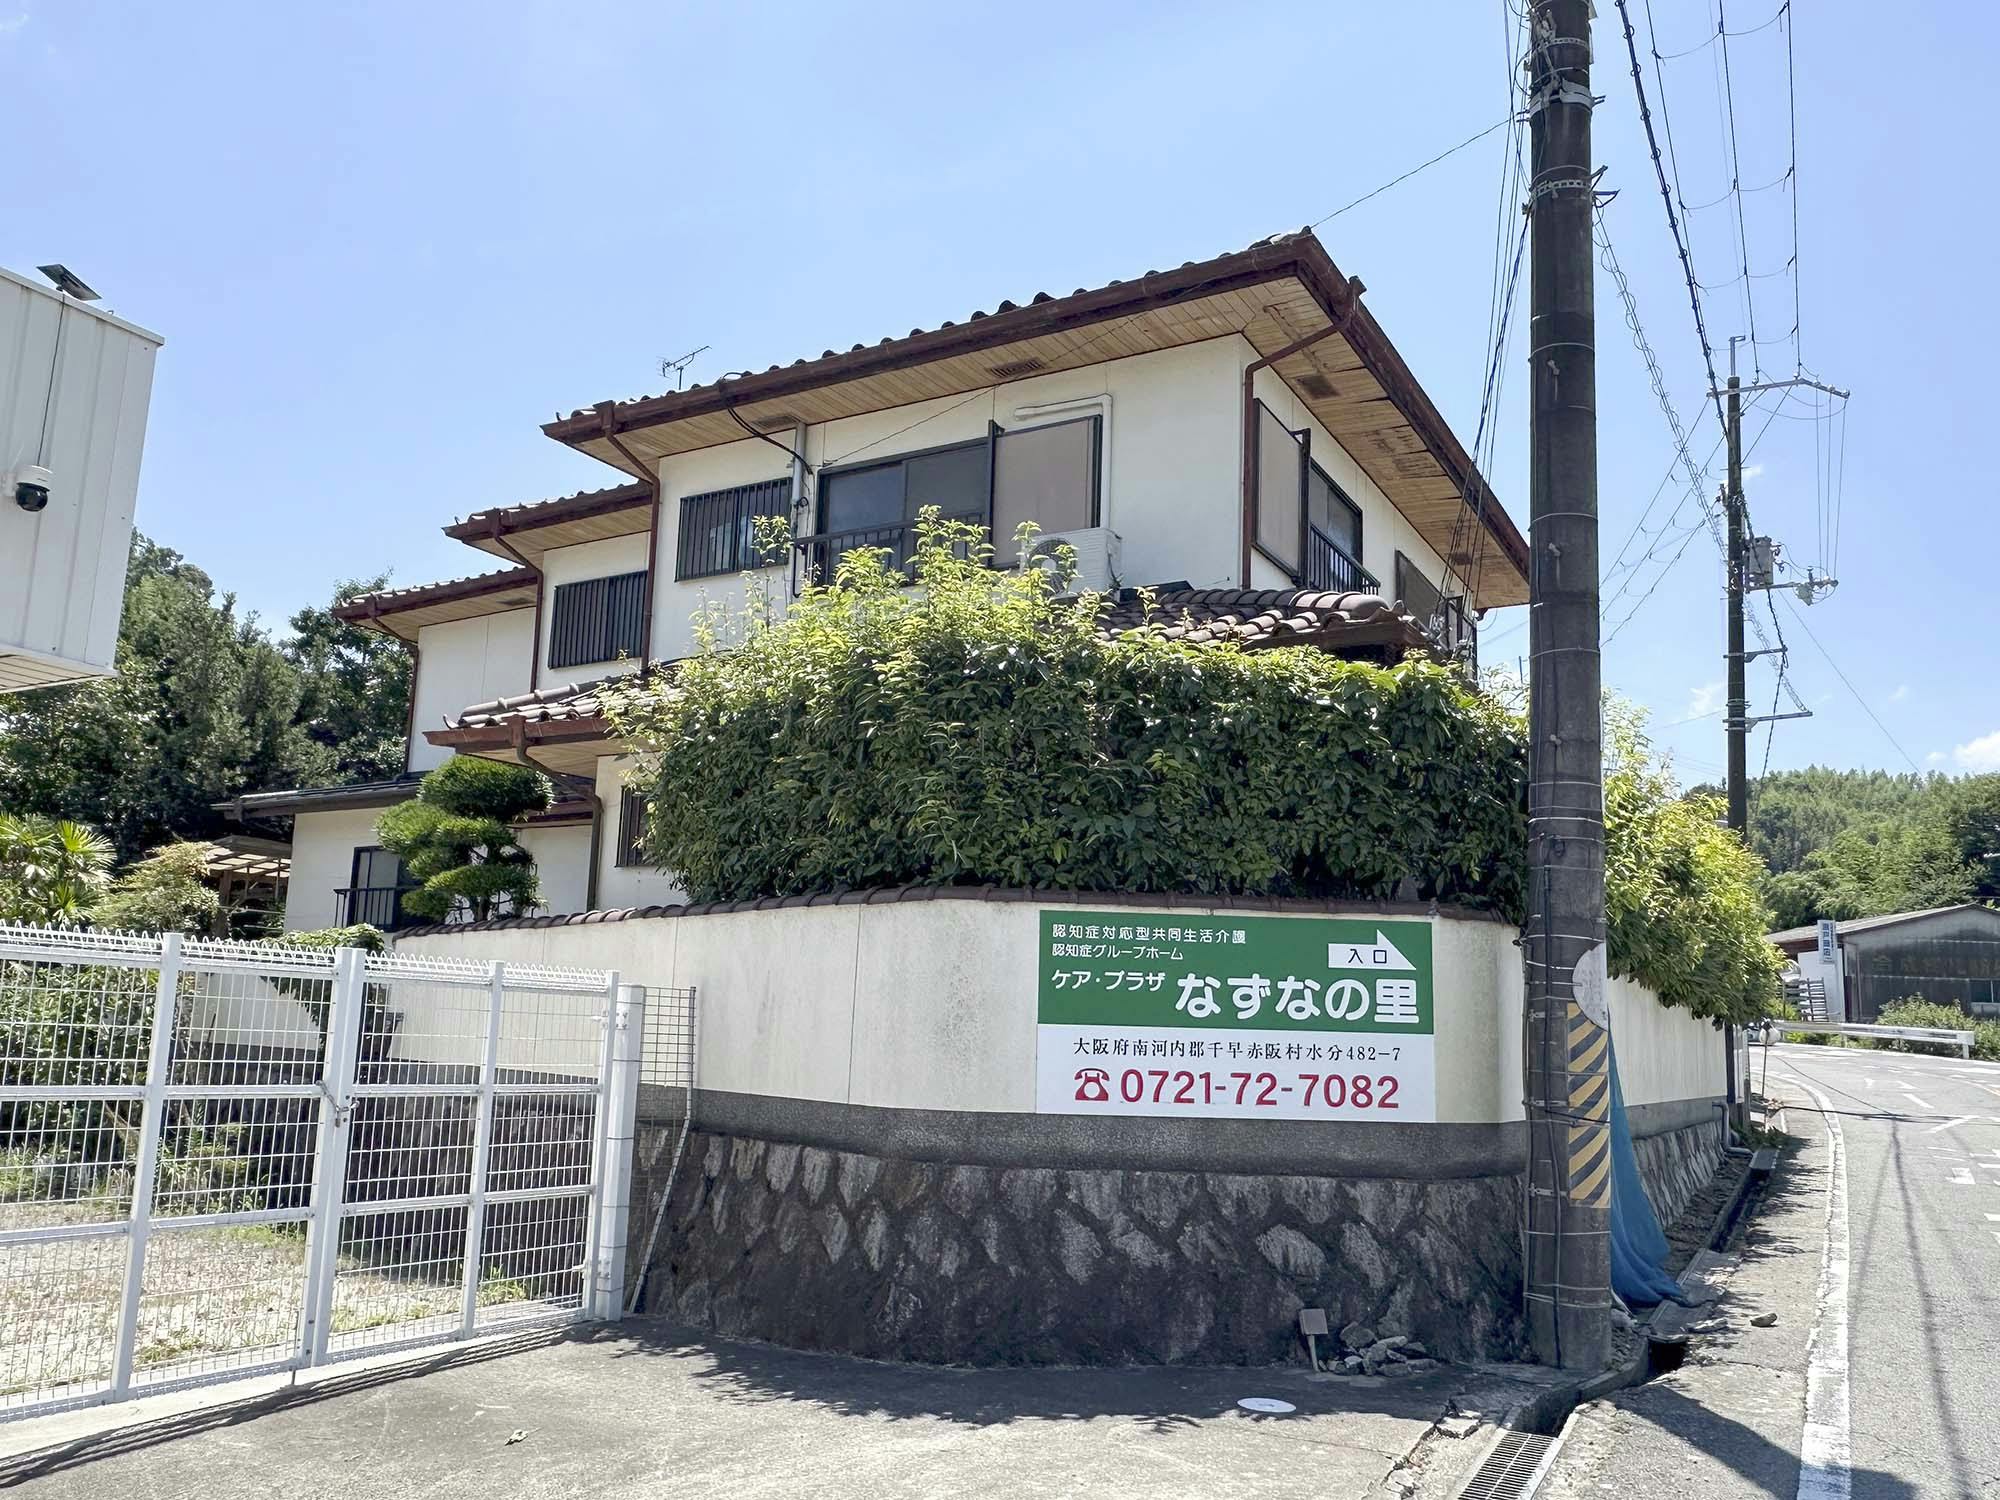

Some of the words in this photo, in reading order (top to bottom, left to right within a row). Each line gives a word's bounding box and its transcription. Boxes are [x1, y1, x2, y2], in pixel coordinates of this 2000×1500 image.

[1052, 924, 1246, 944] 認知症対応型共同生活介護
[1052, 943, 1184, 960] 認知症グループホーム
[1348, 948, 1387, 964] 入口
[1174, 972, 1420, 1023] なずなの里
[1120, 1068, 1399, 1109] 0721-72-7082
